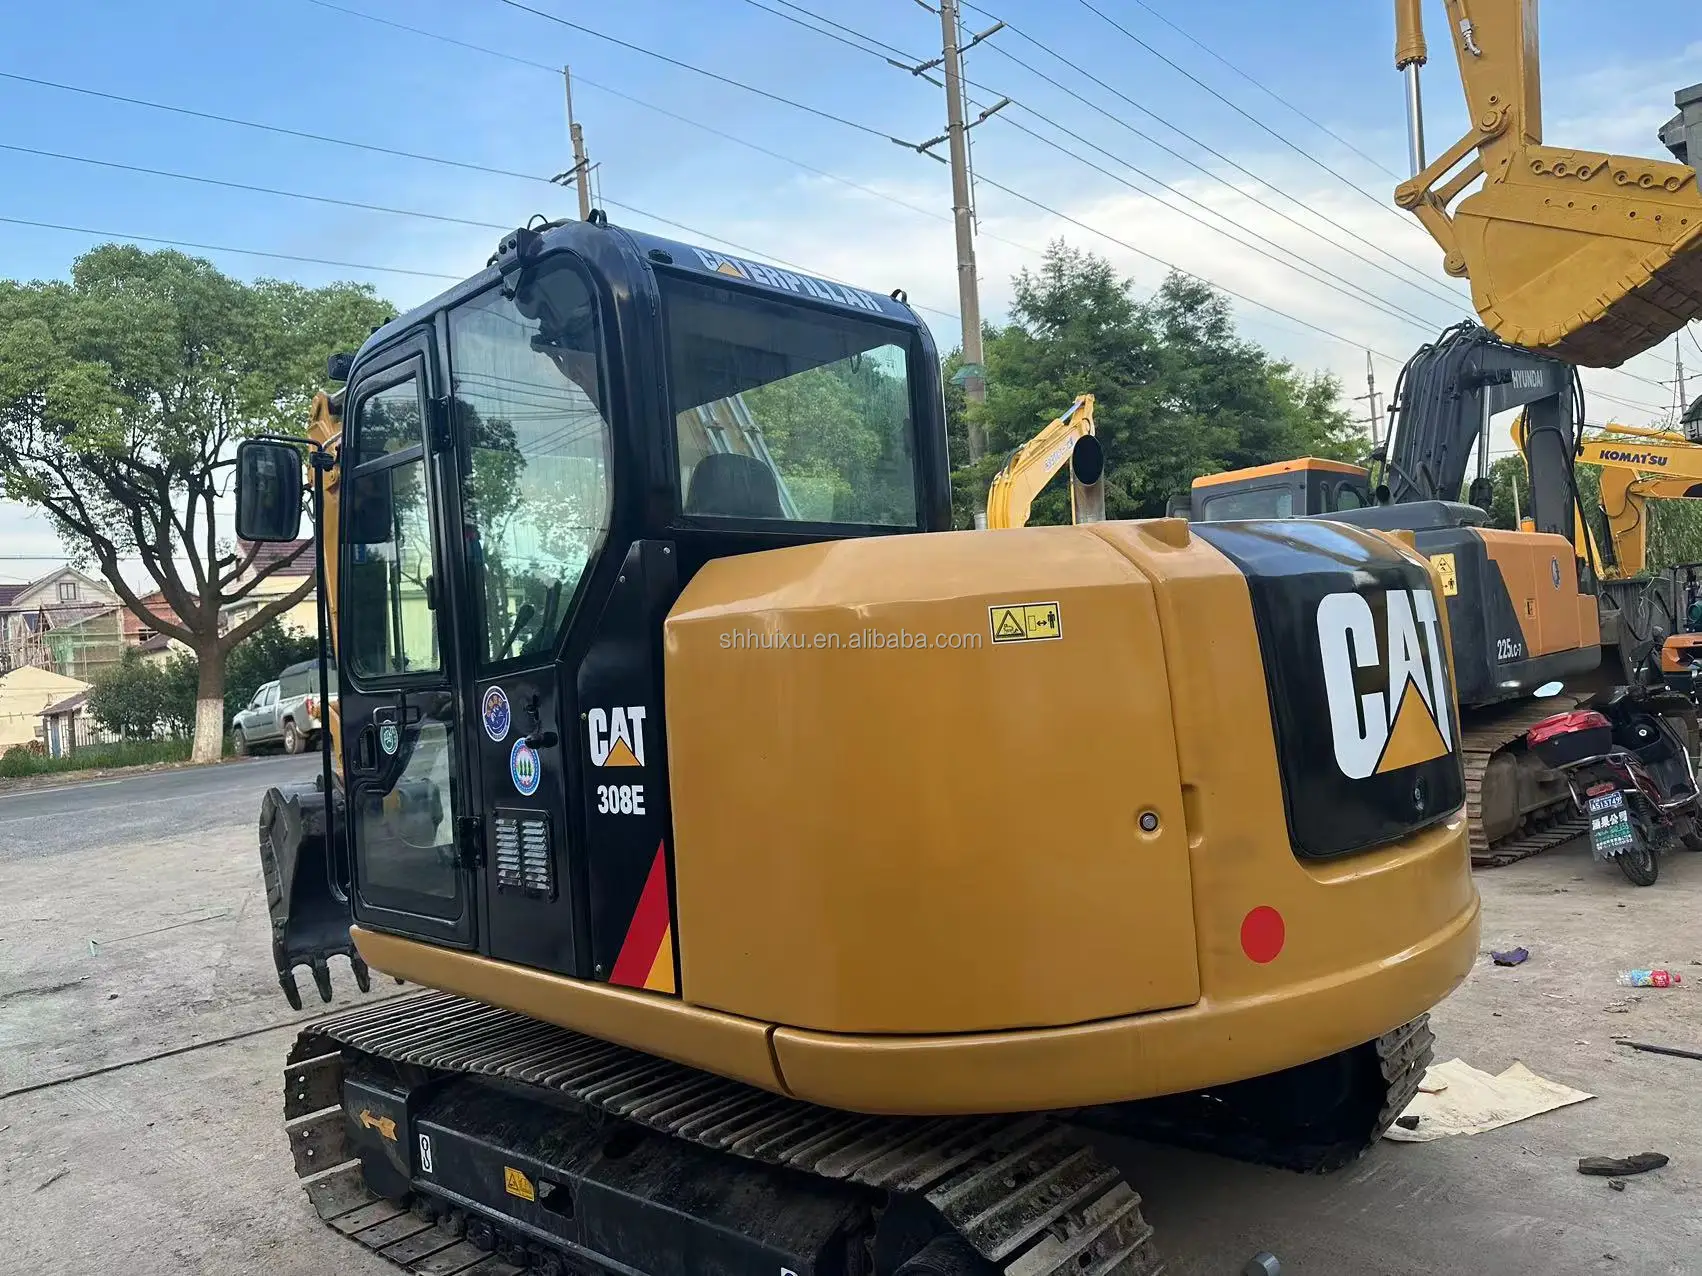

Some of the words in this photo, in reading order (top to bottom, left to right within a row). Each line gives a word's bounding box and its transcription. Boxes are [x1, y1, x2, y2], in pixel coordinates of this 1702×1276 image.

[691, 247, 884, 313] CATERPILLAR
[1511, 369, 1544, 389] HYUNDAI
[1599, 449, 1668, 467] KOMATSU
[1316, 589, 1453, 780] CAT
[588, 706, 646, 767] CAT
[597, 784, 646, 815] 308E
